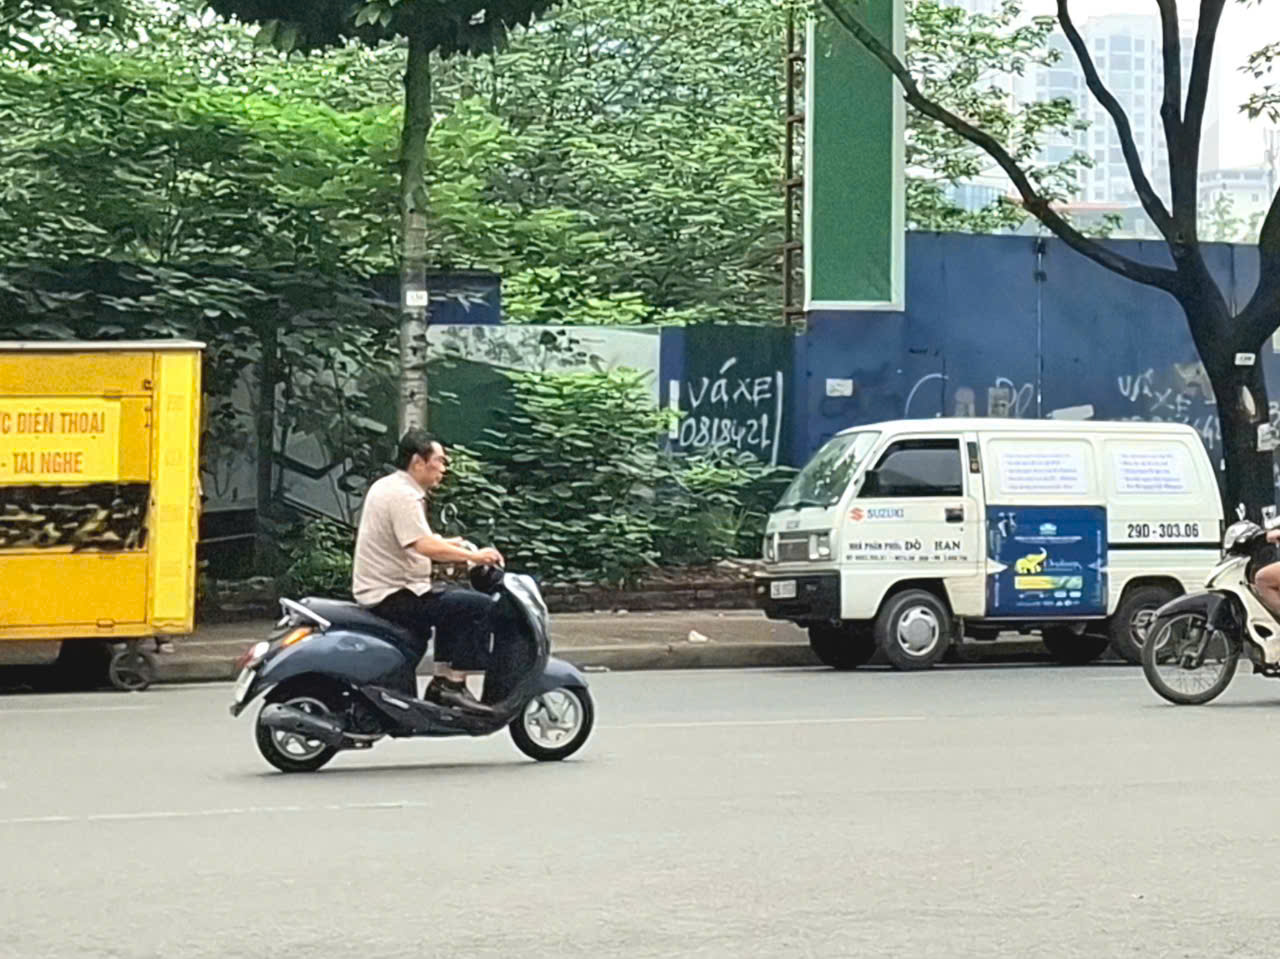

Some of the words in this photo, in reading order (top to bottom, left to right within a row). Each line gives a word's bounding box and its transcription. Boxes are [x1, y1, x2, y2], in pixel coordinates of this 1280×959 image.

[60, 411, 105, 439] THOẠI
[13, 451, 34, 474] TAI
[40, 450, 83, 474] NGHE
[867, 509, 904, 519] SUZUKI
